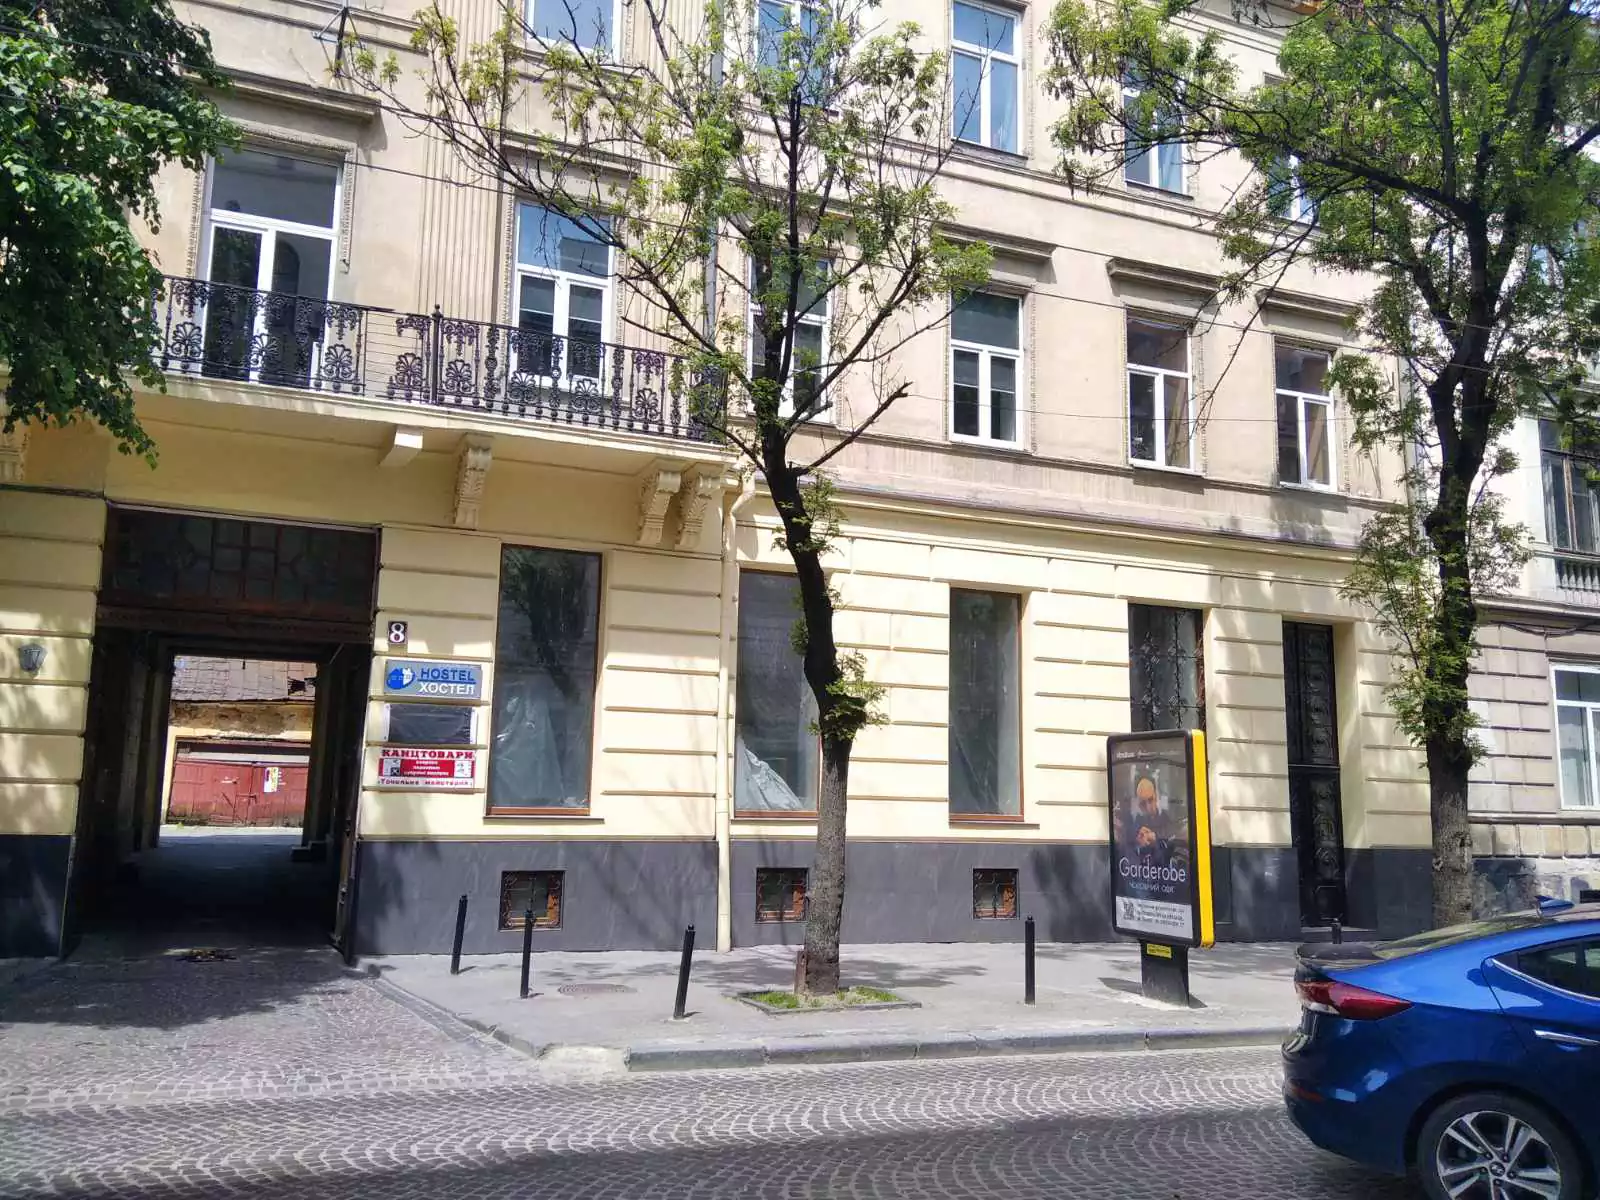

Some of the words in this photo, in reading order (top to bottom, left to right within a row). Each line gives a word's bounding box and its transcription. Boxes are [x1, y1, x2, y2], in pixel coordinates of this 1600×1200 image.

[391, 623, 405, 643] 8
[420, 667, 475, 681] HOSTEL
[419, 682, 475, 694] ХОСТЕЛ
[382, 749, 473, 759] КАНЦТОВАРИ
[1119, 857, 1186, 882] Garderobe
